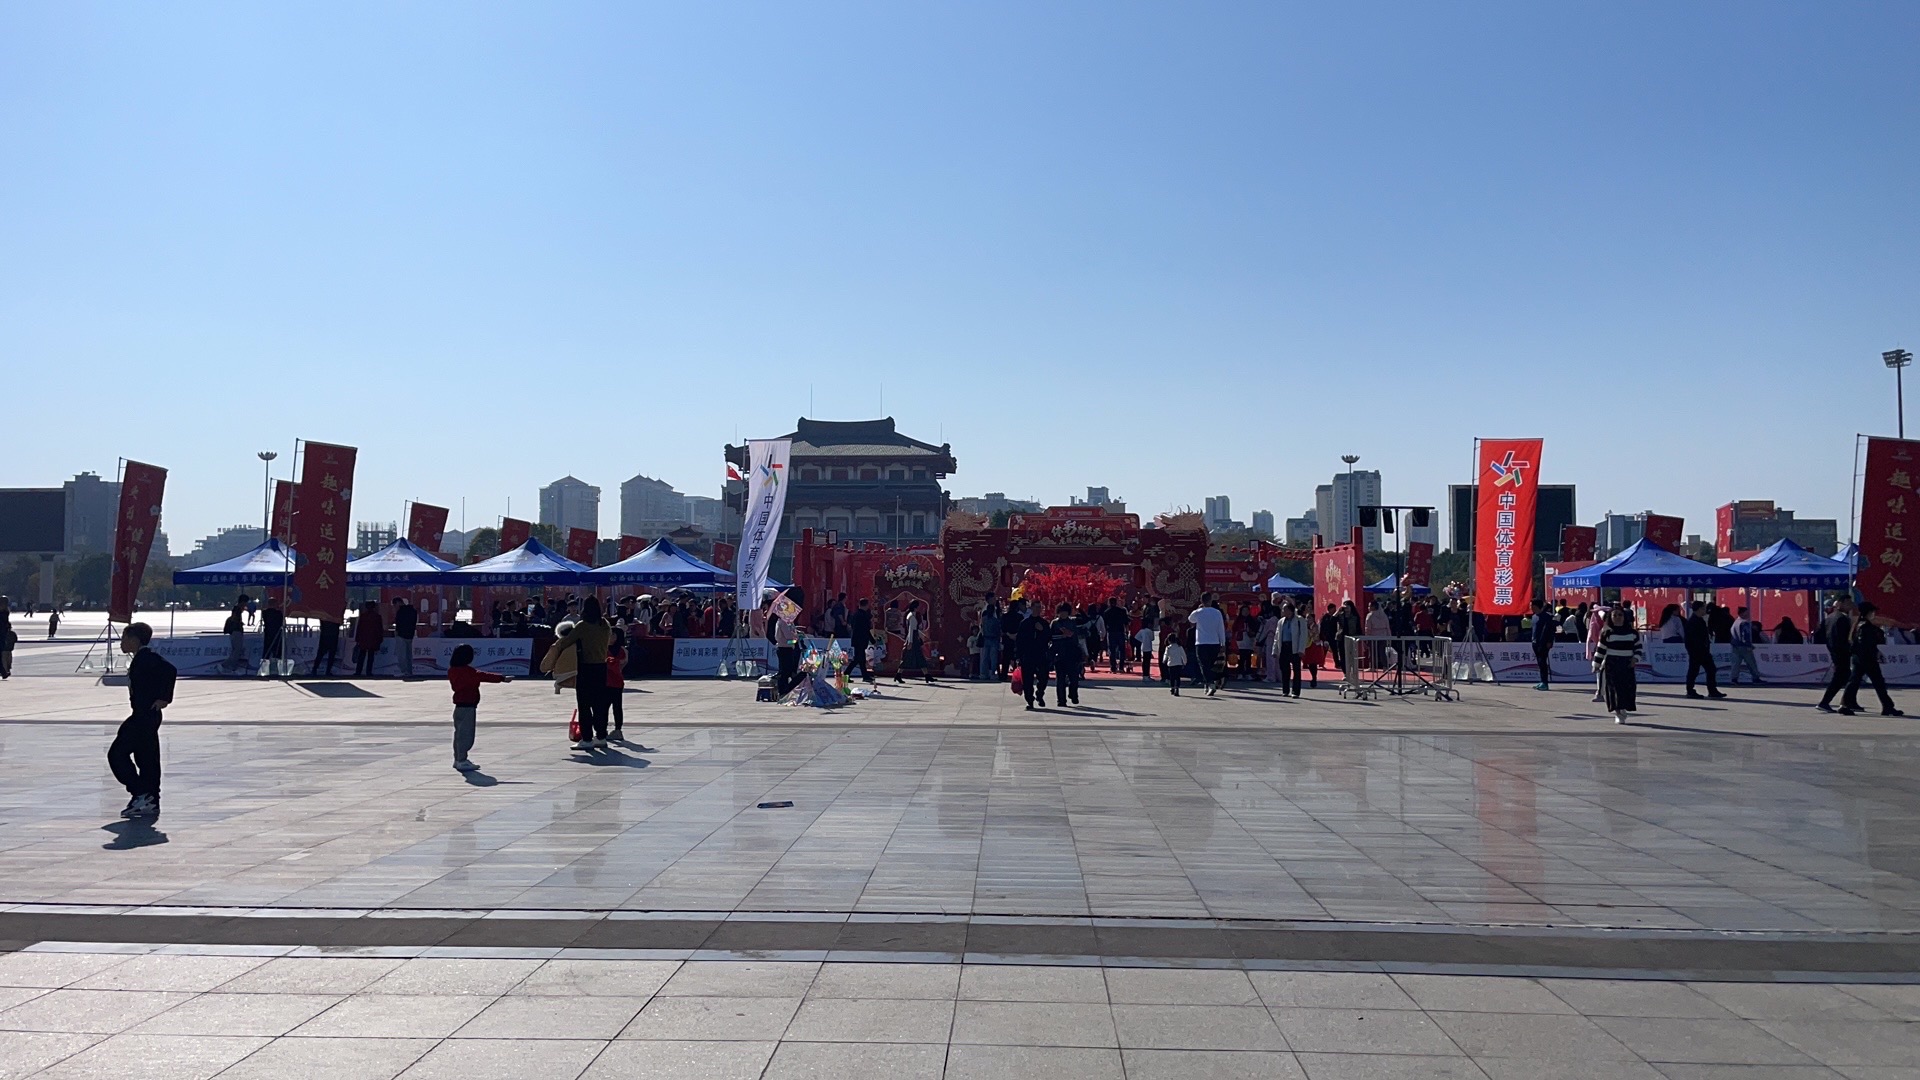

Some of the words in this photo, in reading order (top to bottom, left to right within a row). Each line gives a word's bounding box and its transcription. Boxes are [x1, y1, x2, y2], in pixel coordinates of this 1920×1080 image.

[315, 472, 339, 590] 趣味运动会
[471, 575, 506, 583] 公益体彩
[510, 574, 545, 583] 乐善人生
[739, 493, 774, 597] 中国体育彩票
[1492, 490, 1517, 606] 中国体育彩票
[1877, 468, 1912, 594] 趣味运动会
[443, 646, 482, 656] 公彩
[487, 646, 526, 657] 乐善人生
[676, 646, 719, 657] 中国体育彩票
